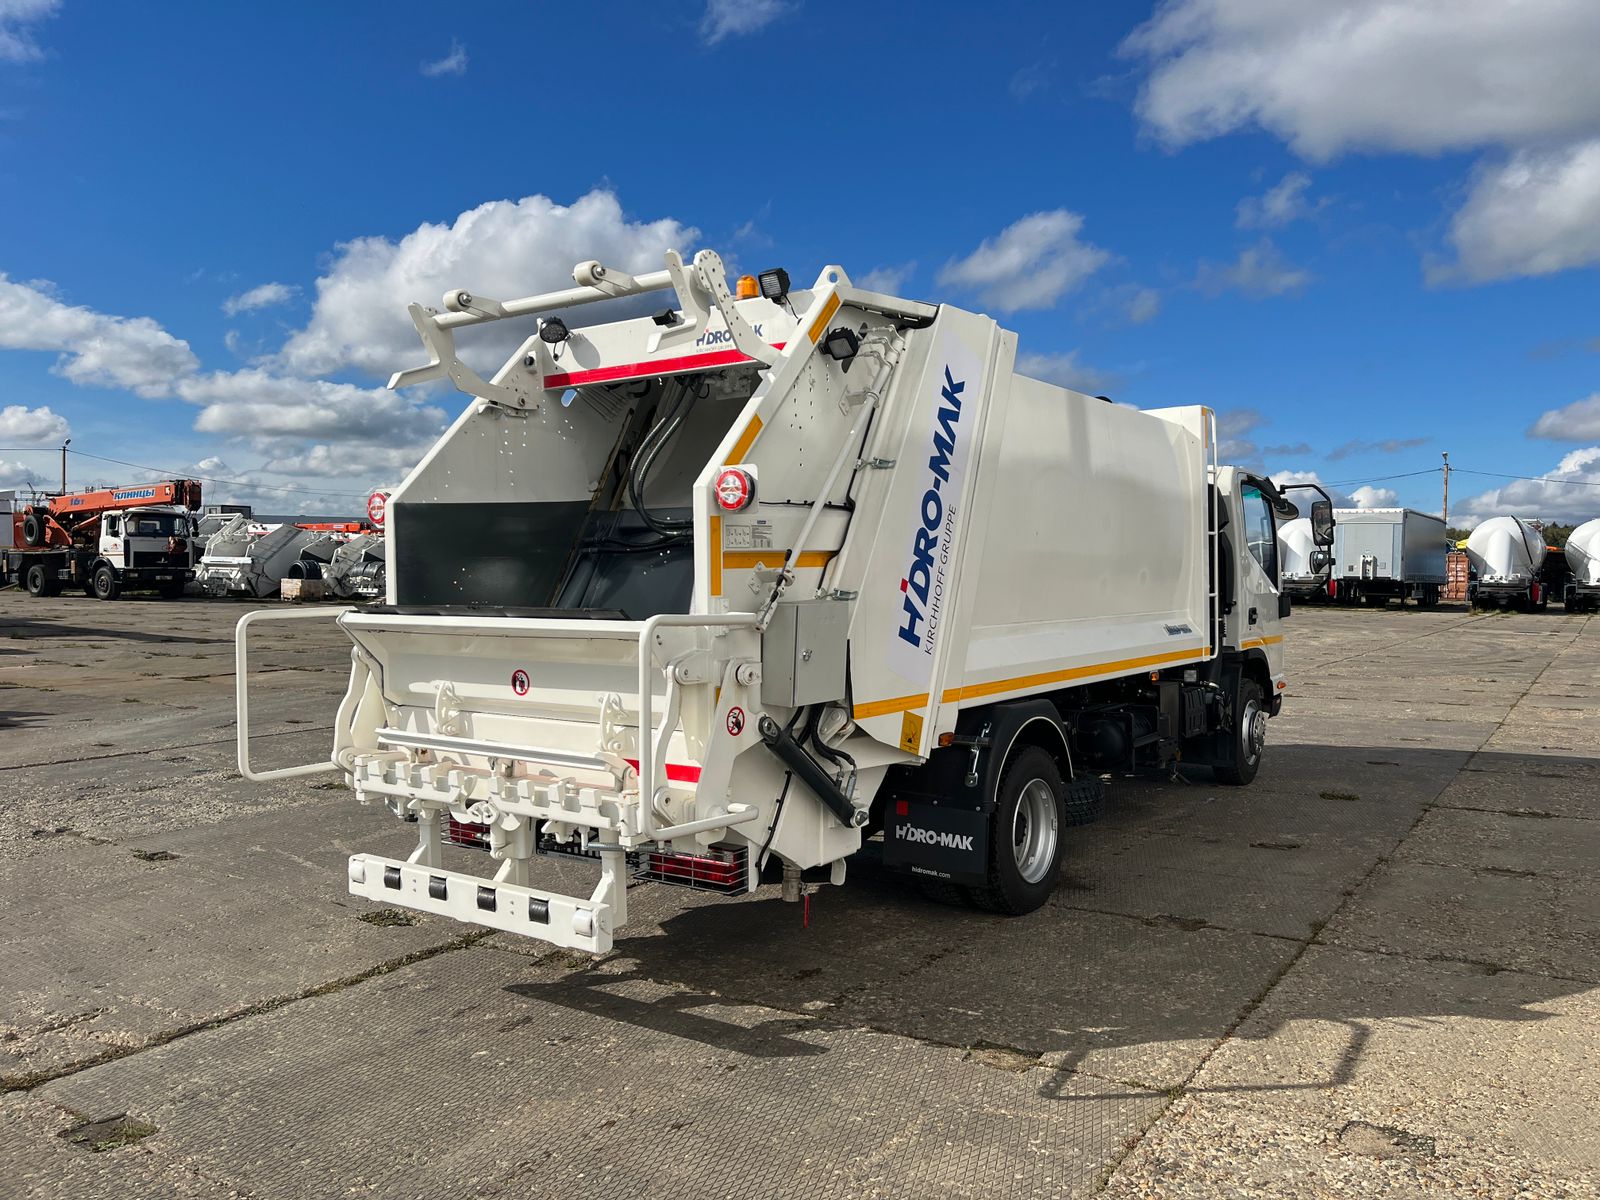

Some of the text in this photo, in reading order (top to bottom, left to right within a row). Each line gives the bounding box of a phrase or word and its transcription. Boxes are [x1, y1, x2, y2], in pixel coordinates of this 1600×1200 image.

[114, 489, 155, 499] КЛИНЦЫ
[924, 503, 957, 655] KIRCHHOFF GRUPPE
[911, 865, 951, 878] hidromak.com
